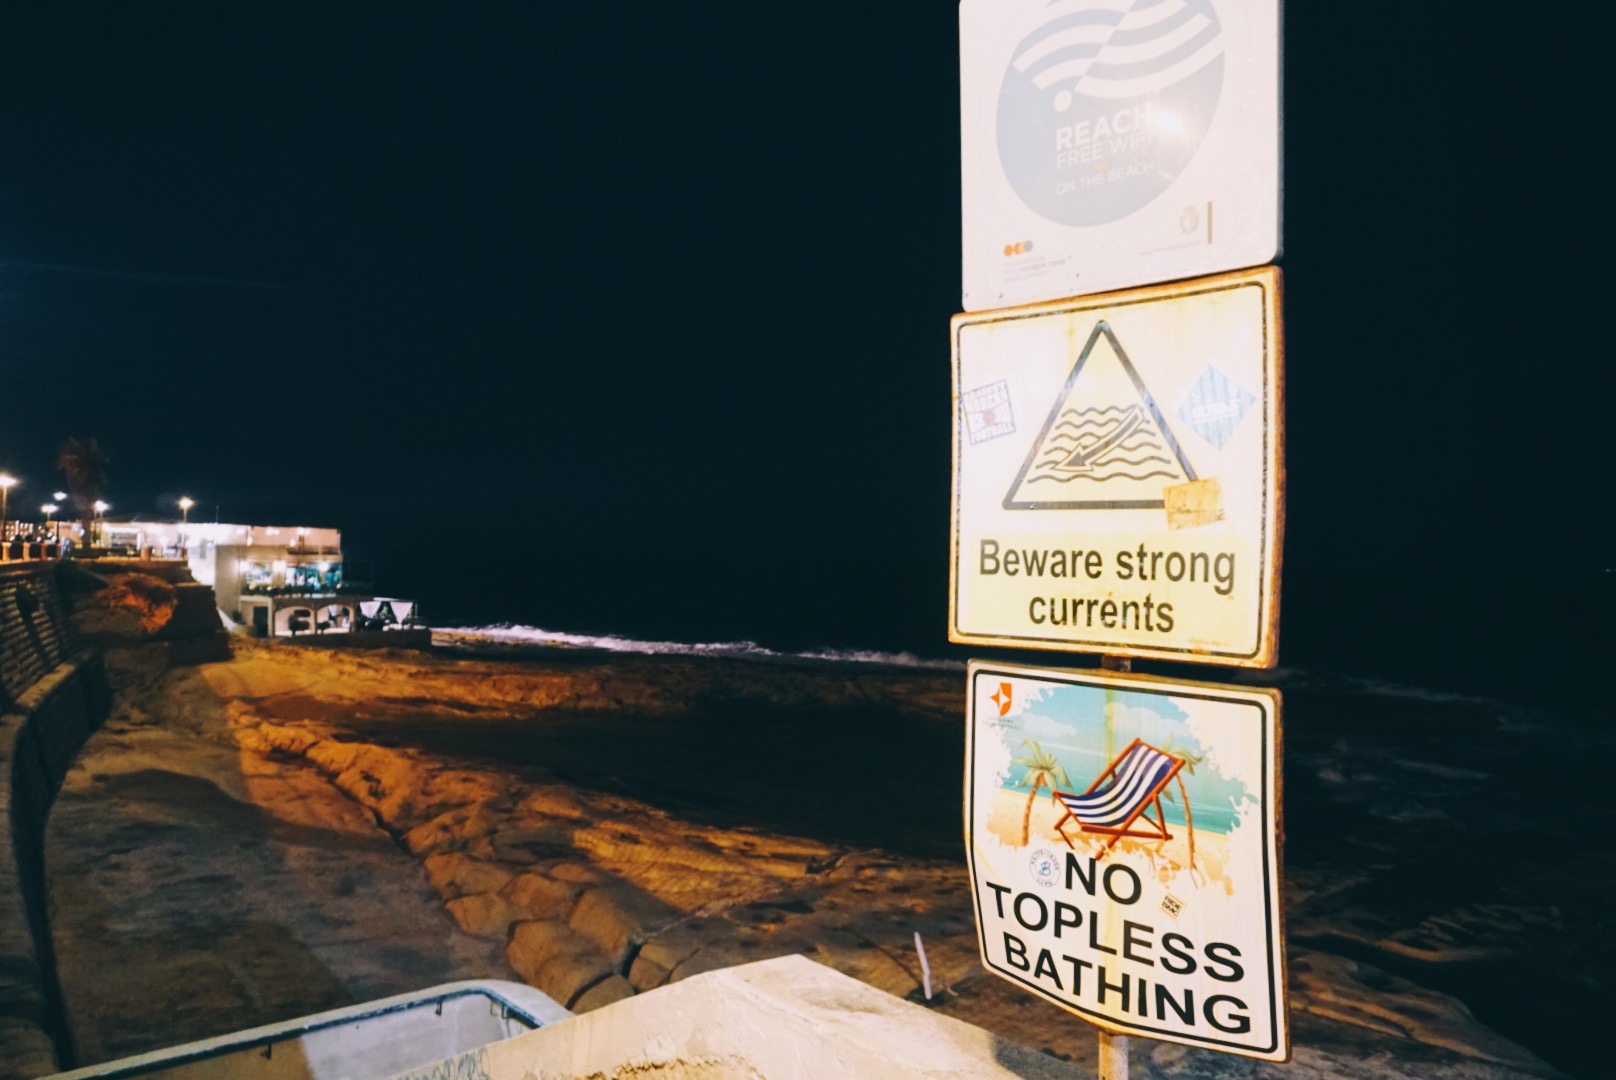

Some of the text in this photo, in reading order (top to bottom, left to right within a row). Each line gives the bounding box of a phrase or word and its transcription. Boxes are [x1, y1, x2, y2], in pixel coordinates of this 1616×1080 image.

[1056, 101, 1153, 151] REACH
[1056, 142, 1105, 168] FREE
[1056, 161, 1154, 195] ON THE BEACH
[979, 539, 1235, 595] Beware strong
[1029, 593, 1175, 633] currents
[1065, 852, 1142, 905] NO
[986, 881, 1245, 982] TOPLESS
[1003, 931, 1251, 1035] BATHING
